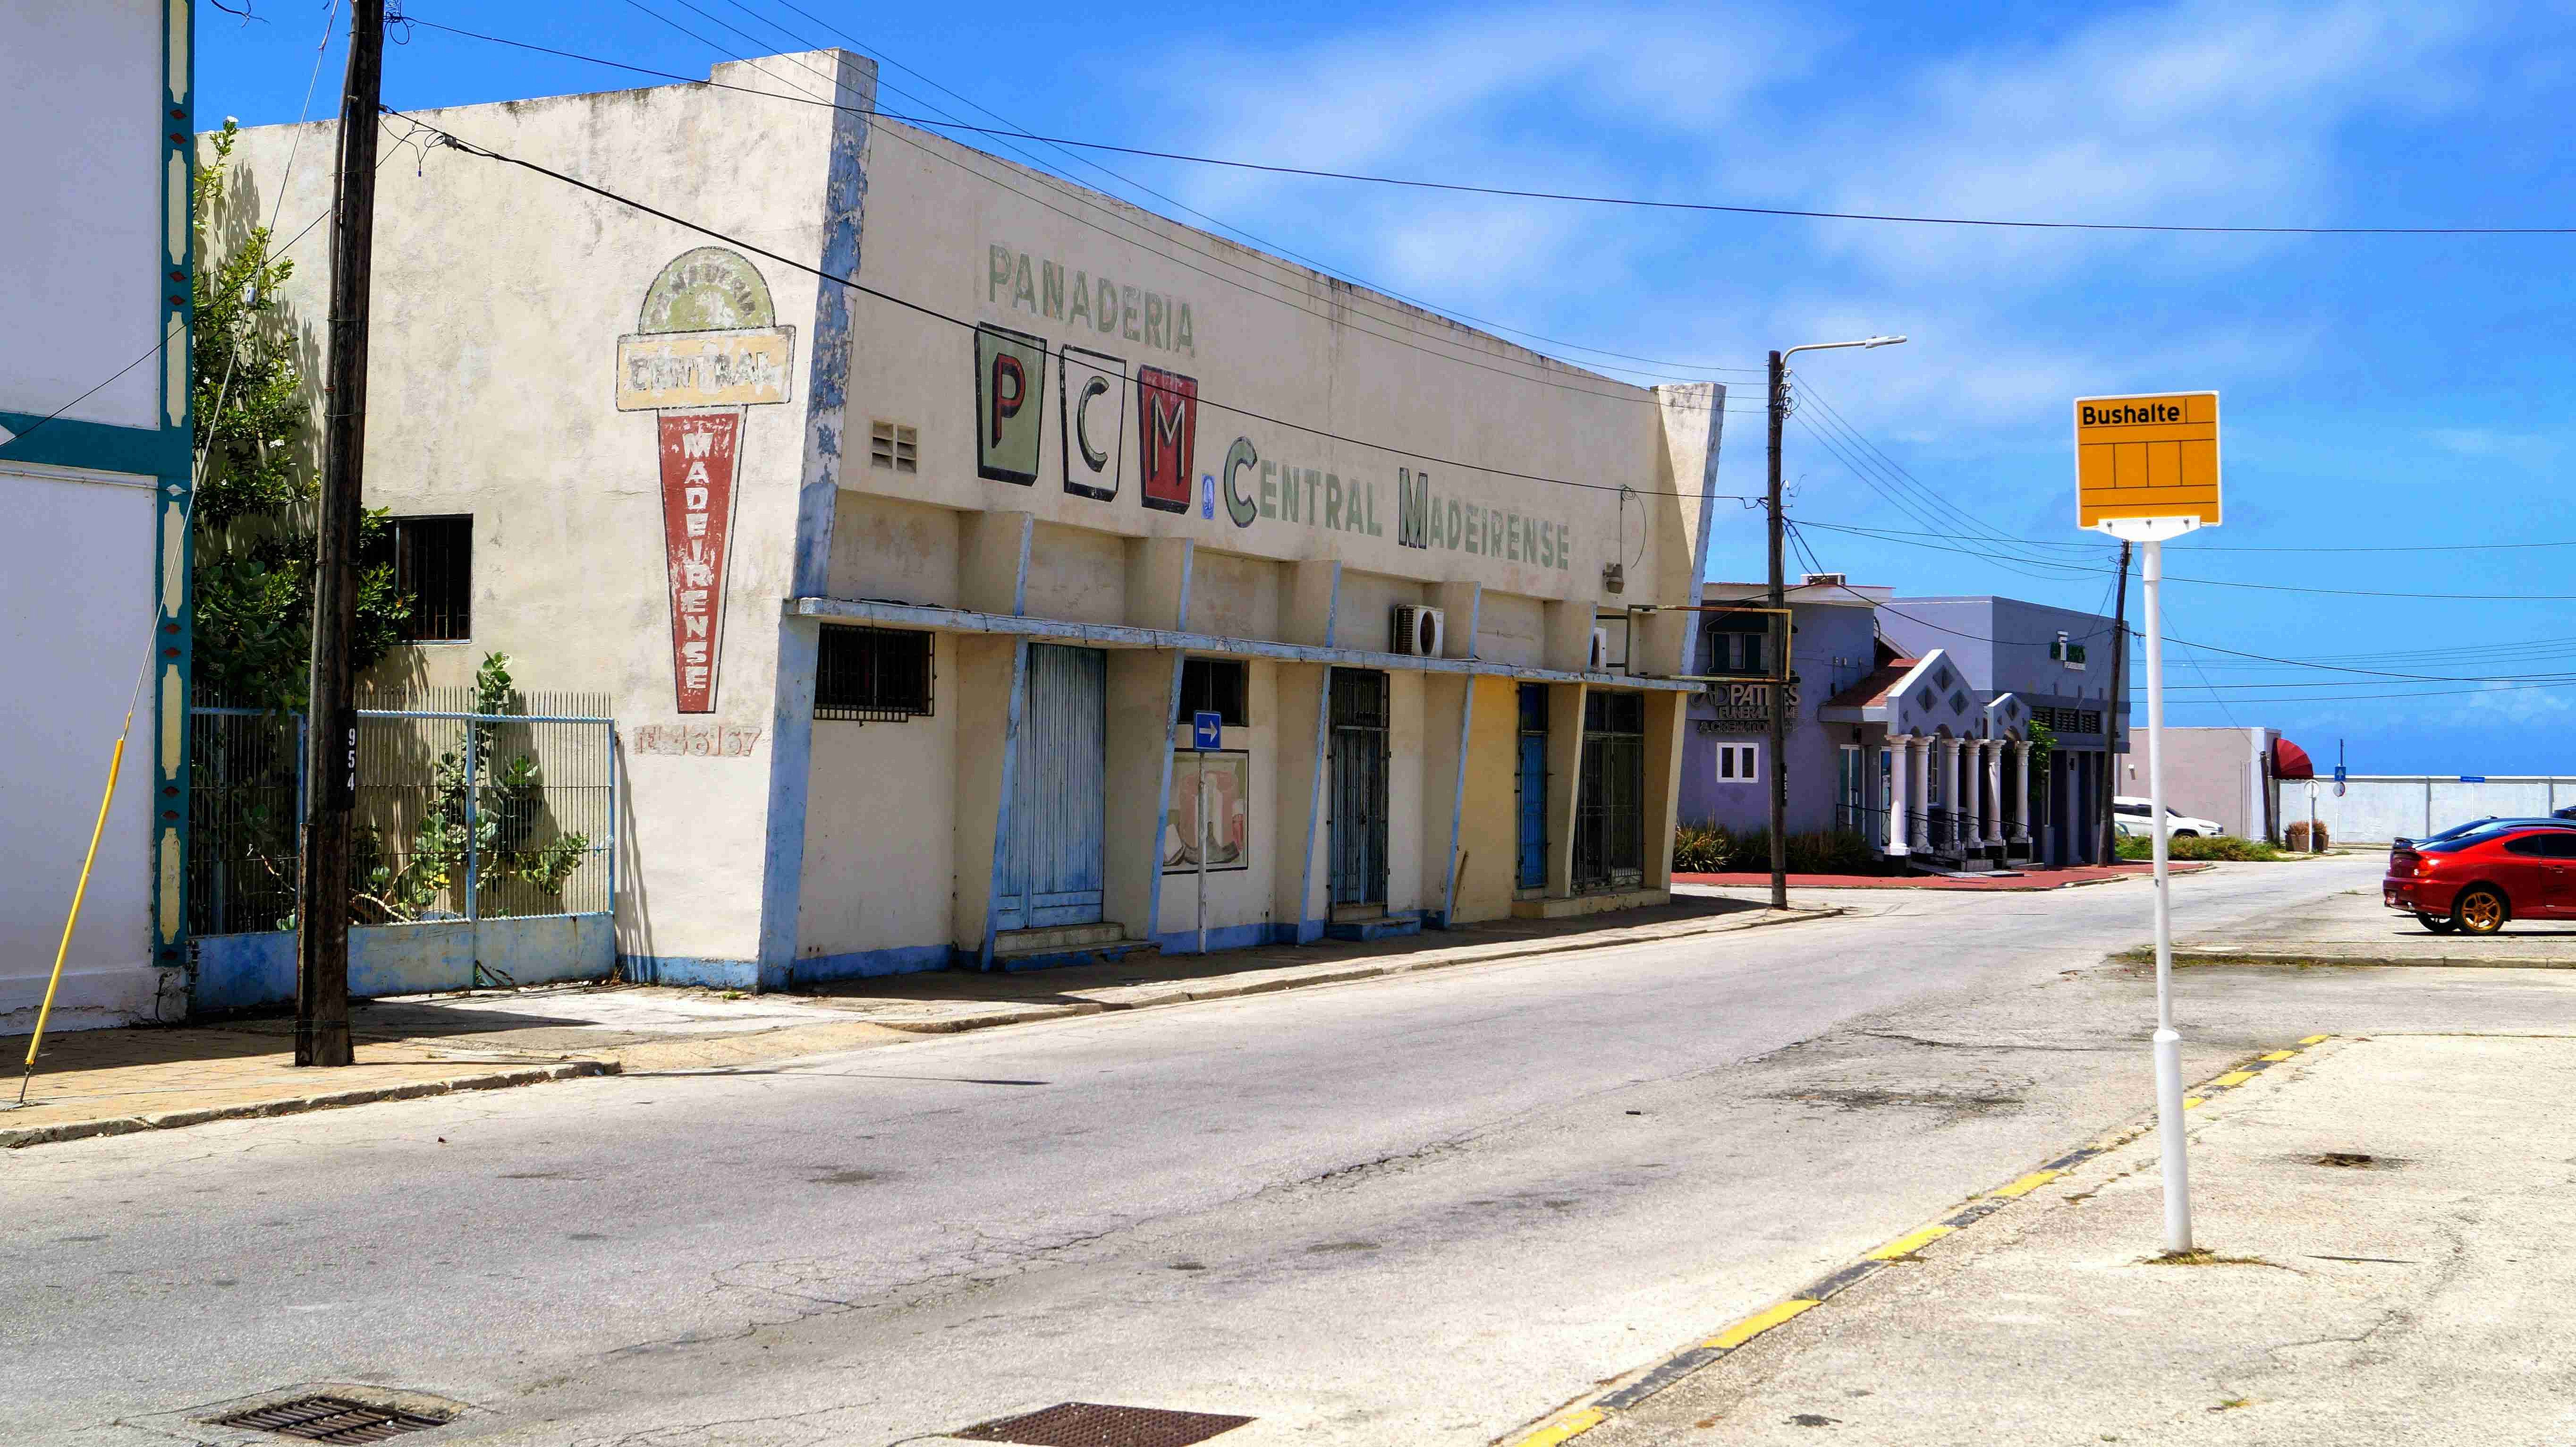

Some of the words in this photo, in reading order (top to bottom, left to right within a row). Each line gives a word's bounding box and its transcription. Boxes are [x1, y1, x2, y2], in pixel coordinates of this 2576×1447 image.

[989, 244, 1195, 358] PANADERIA
[2082, 403, 2180, 425] Bushalte
[1223, 435, 1383, 537] CENTRAL
[1398, 467, 1569, 570] MADEIRENSE
[680, 432, 714, 689] MADEIRENSE
[347, 728, 356, 791] 954
